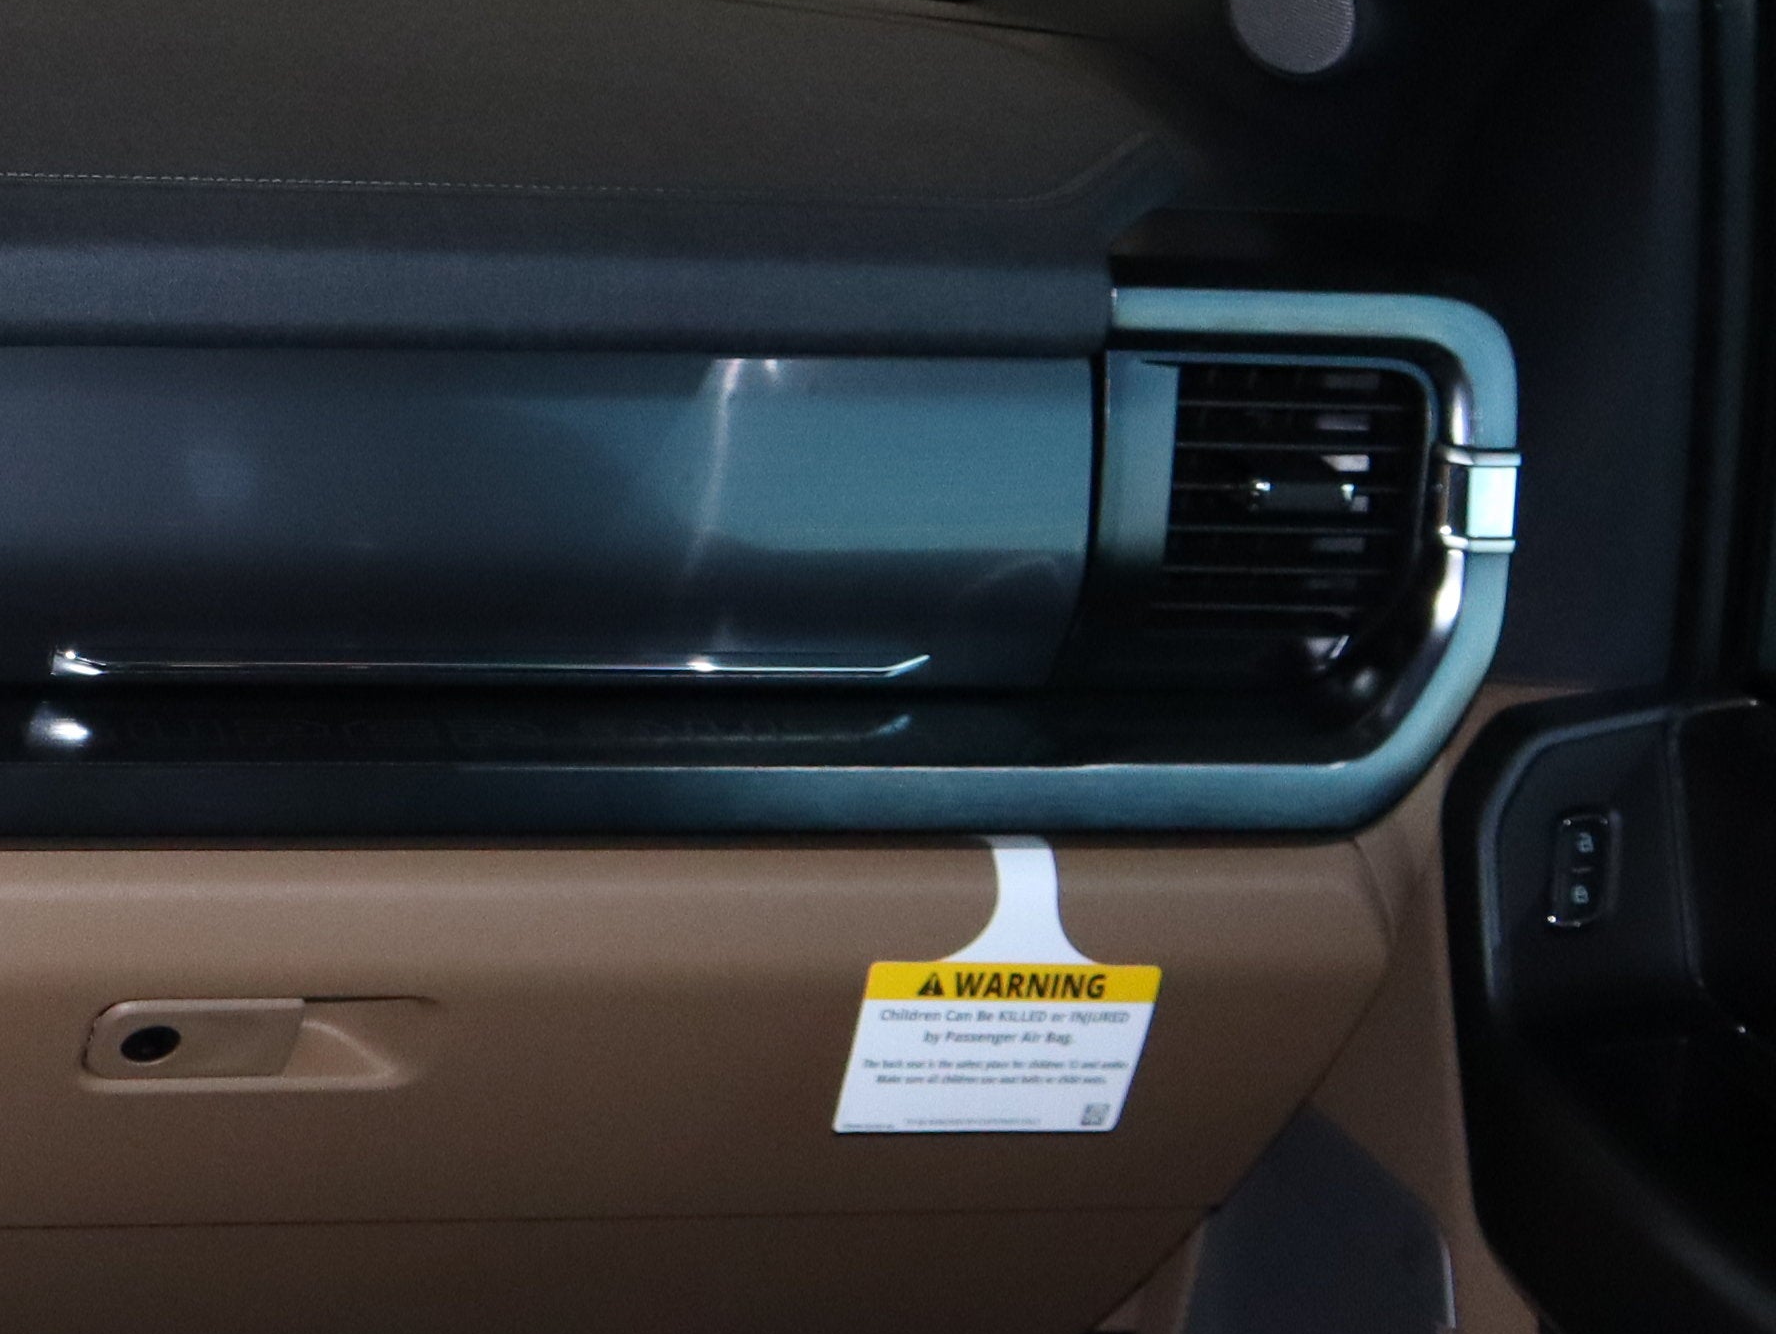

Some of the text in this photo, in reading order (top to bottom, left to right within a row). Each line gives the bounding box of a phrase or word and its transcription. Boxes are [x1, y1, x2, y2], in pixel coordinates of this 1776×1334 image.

[955, 971, 1107, 999] WARNING
[880, 1008, 942, 1022] Children
[945, 1009, 974, 1023] Can
[977, 1009, 995, 1022] Be
[999, 1010, 1048, 1024] KILLED
[1069, 1010, 1131, 1026] INJURED
[923, 1030, 941, 1045] by
[945, 1030, 1017, 1046] Passenger
[1021, 1031, 1042, 1044] Air
